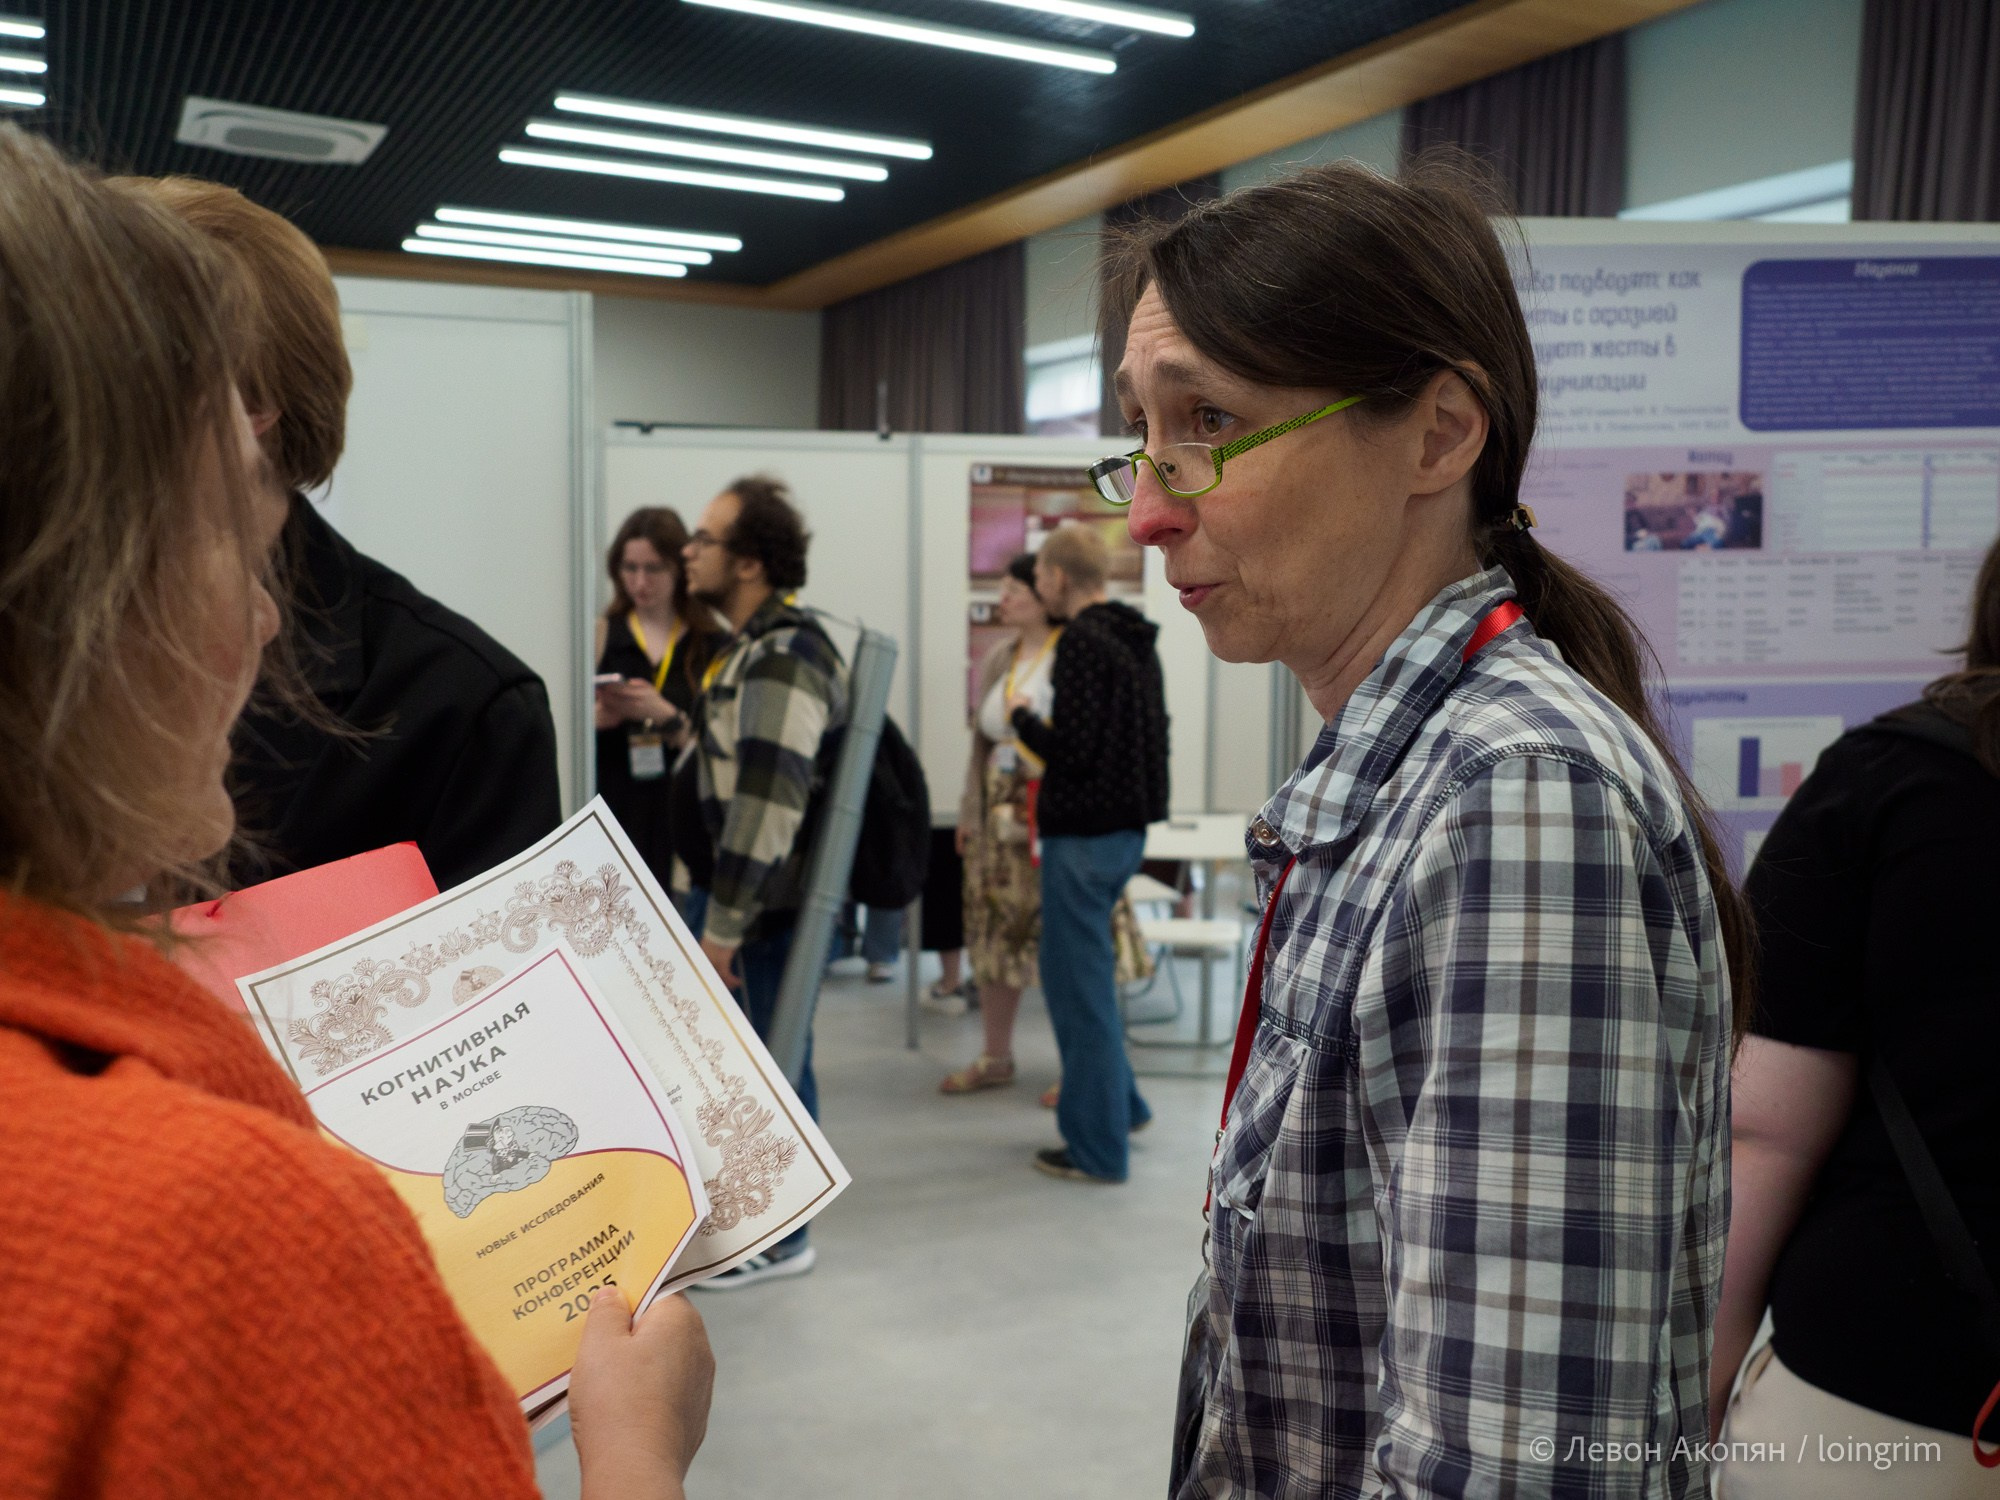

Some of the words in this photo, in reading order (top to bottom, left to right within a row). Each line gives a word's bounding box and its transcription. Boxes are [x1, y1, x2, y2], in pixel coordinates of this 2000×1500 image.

[1515, 270, 1555, 291] ова
[1668, 271, 1699, 289] как
[1573, 307, 1585, 325] с
[1591, 341, 1659, 357] жесты
[360, 1001, 531, 1106] КОГНИТИВНАЯ
[411, 1045, 507, 1105] НАУКА
[439, 1101, 449, 1111] В
[452, 1070, 503, 1104] МОСКВЕ
[475, 1231, 518, 1260] НОВЫЕ
[520, 1172, 606, 1234] ИССЛЕДОВАНИЯ
[512, 1230, 636, 1321] КОНФЕРЕНЦИИ
[513, 1223, 620, 1298] ПРОГРАММА
